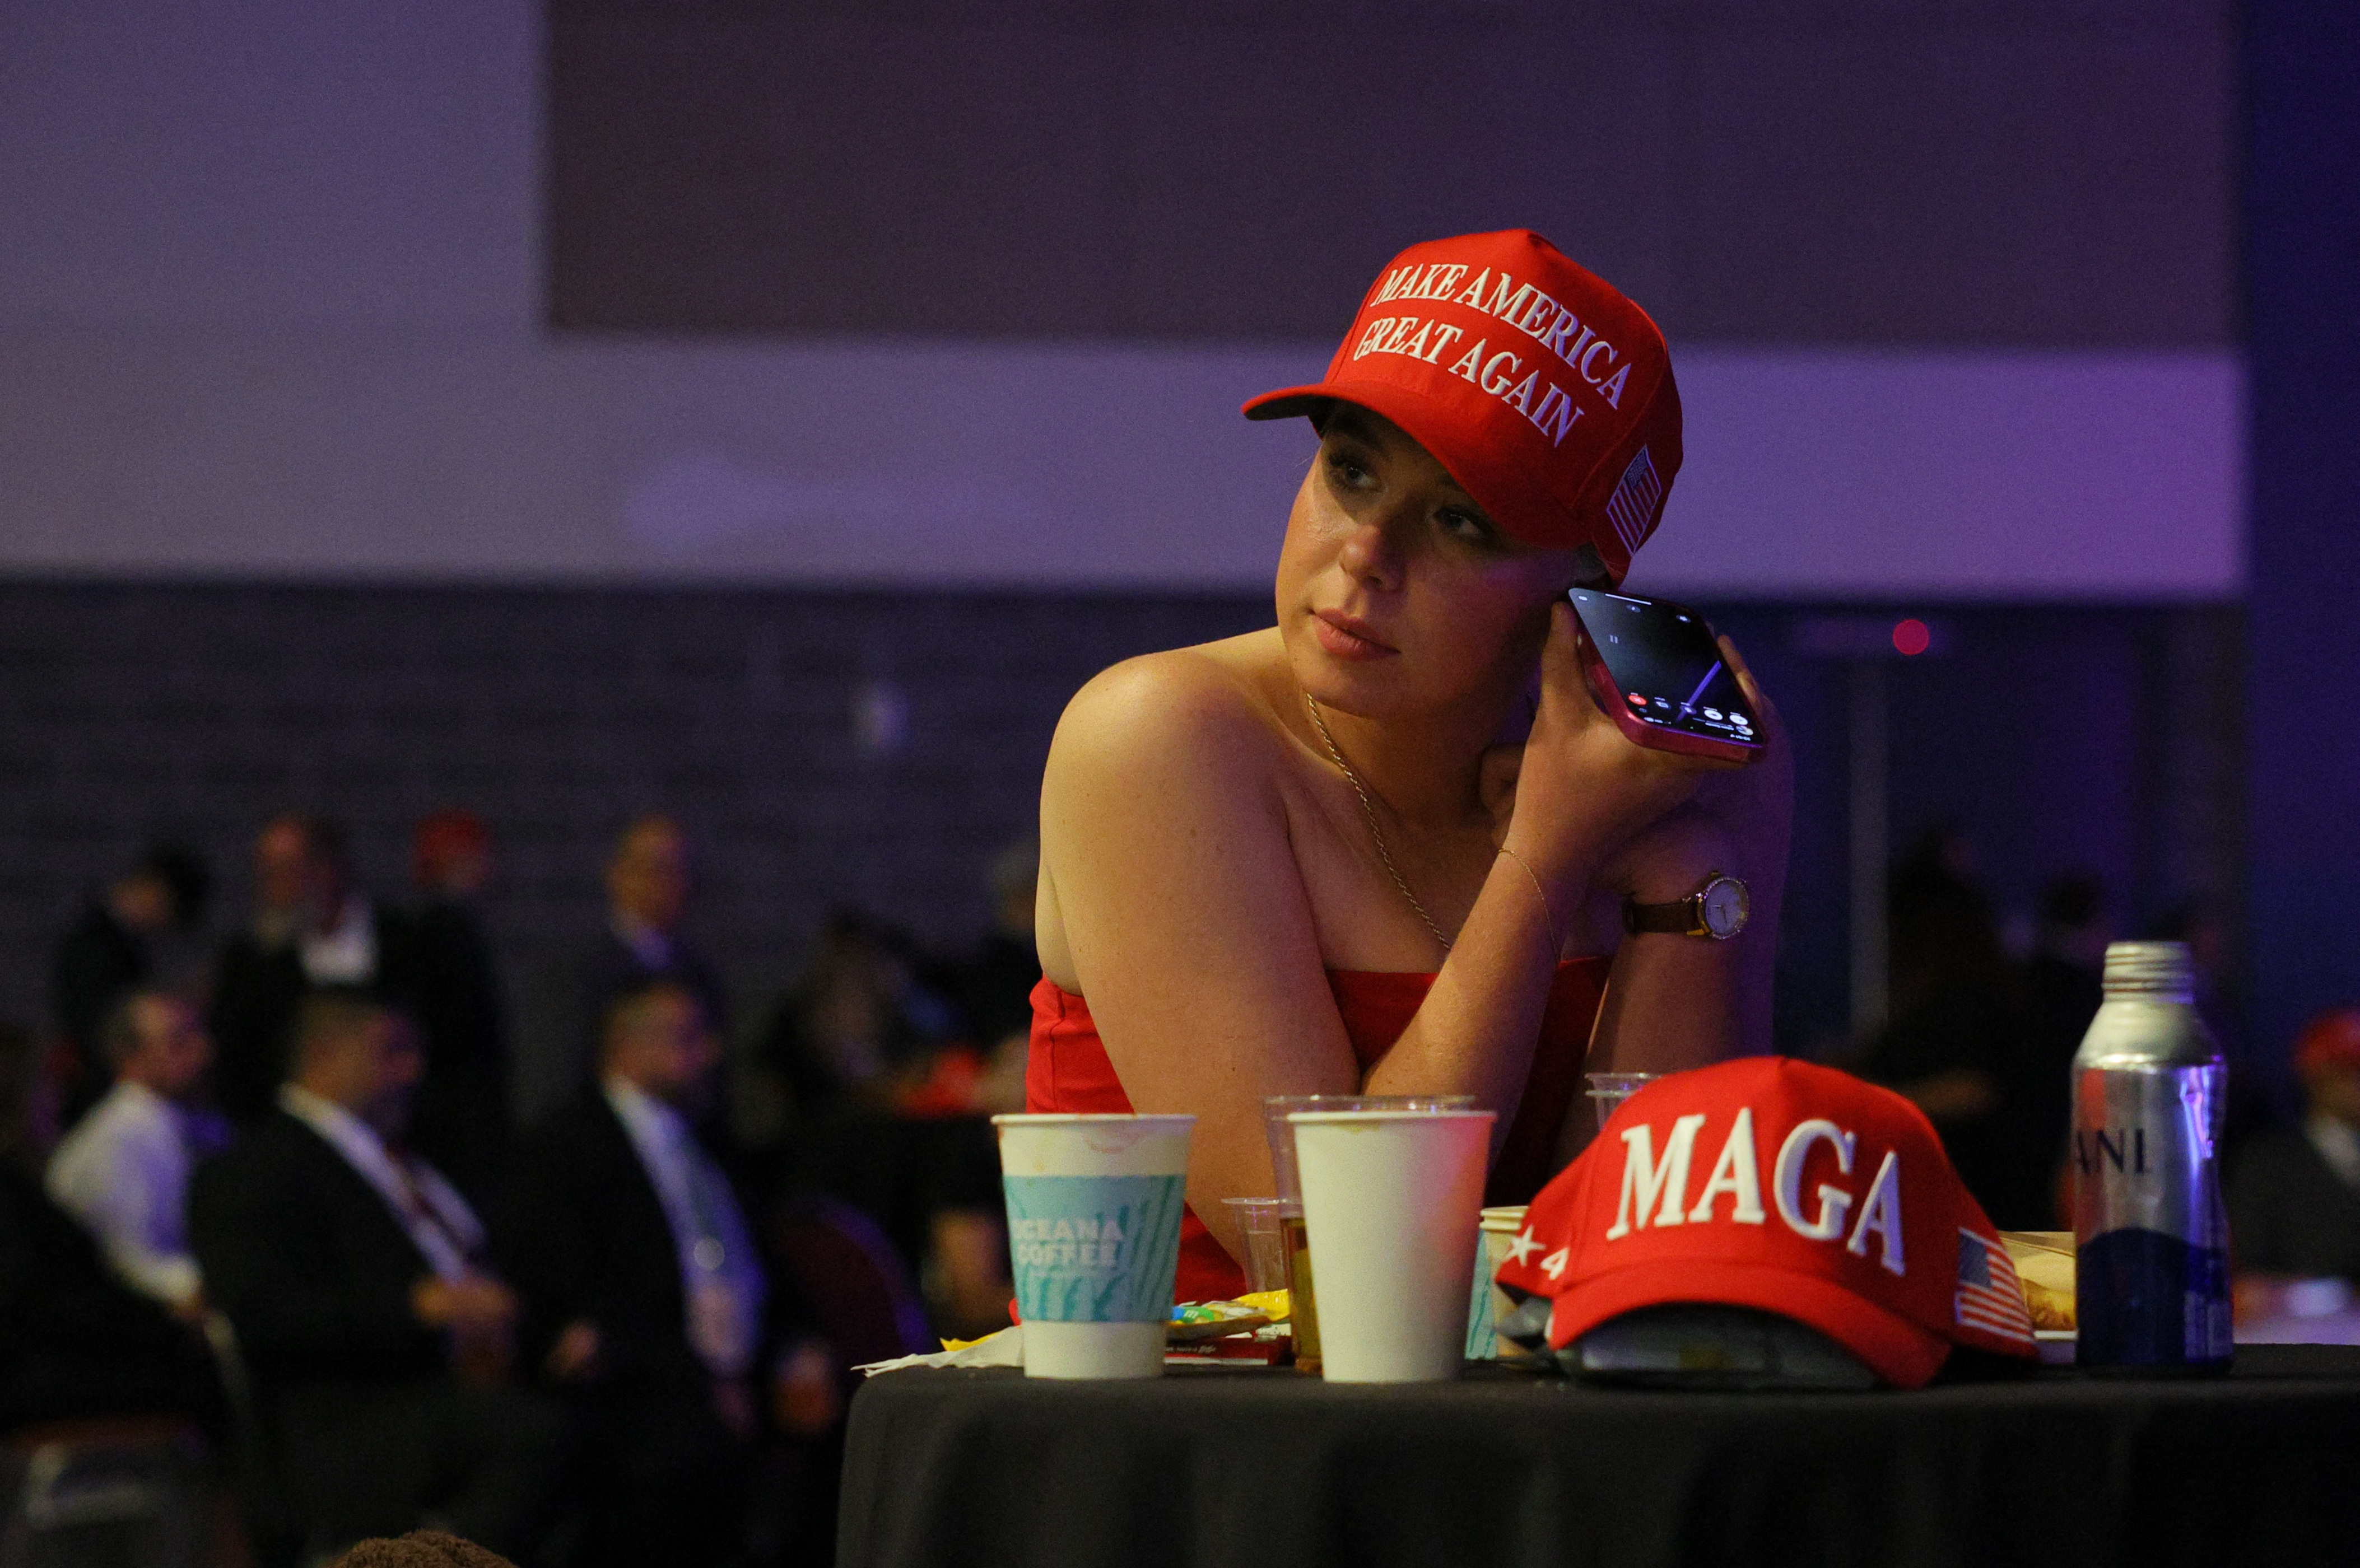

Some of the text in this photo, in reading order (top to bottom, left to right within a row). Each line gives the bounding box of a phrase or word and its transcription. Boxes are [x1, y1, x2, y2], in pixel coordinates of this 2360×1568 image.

[1353, 316, 1584, 447] GREAT AGAIN
[1370, 263, 1632, 410] MAKE AMERICA
[1016, 1242, 1116, 1266] COFFEE
[1606, 1107, 1905, 1277] MAGA
